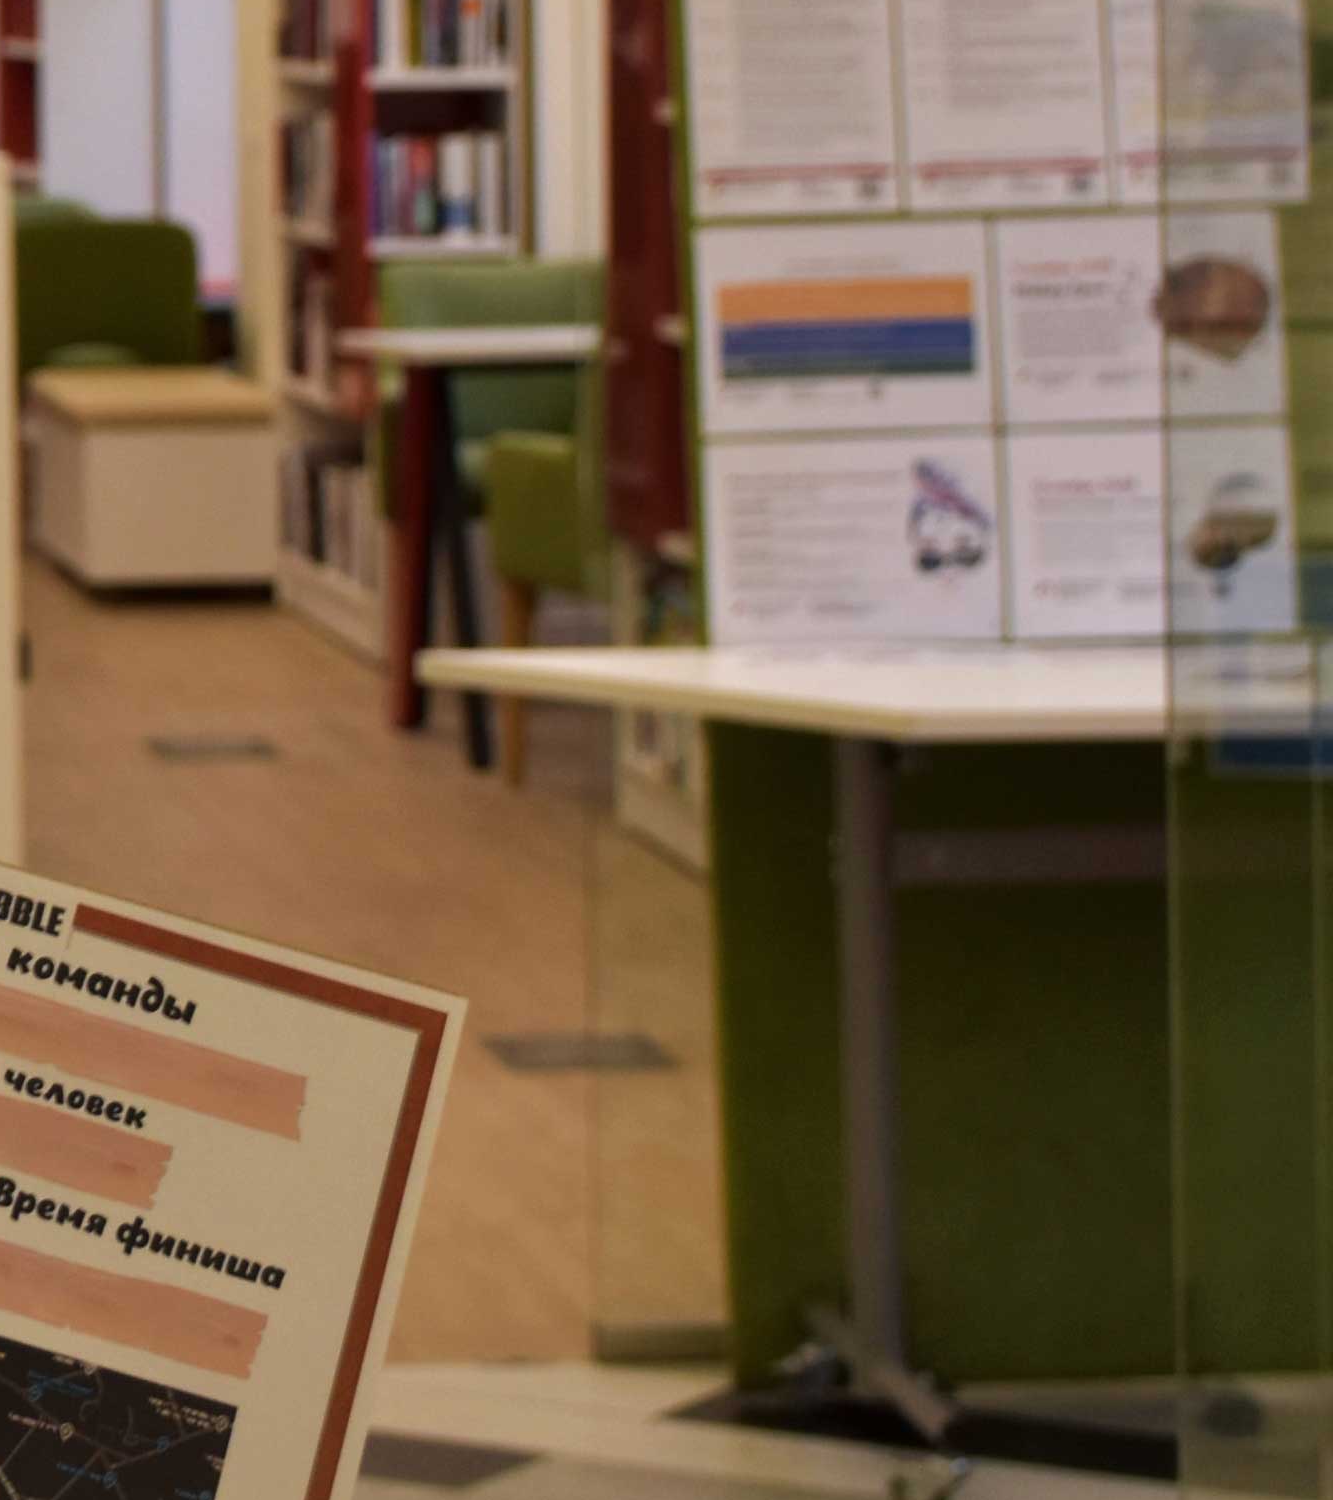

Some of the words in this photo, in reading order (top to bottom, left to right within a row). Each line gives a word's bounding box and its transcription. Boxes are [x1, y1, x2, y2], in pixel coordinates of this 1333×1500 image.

[6, 947, 197, 1025] команды
[4, 1068, 147, 1129] человек
[115, 1214, 286, 1290] финиша
